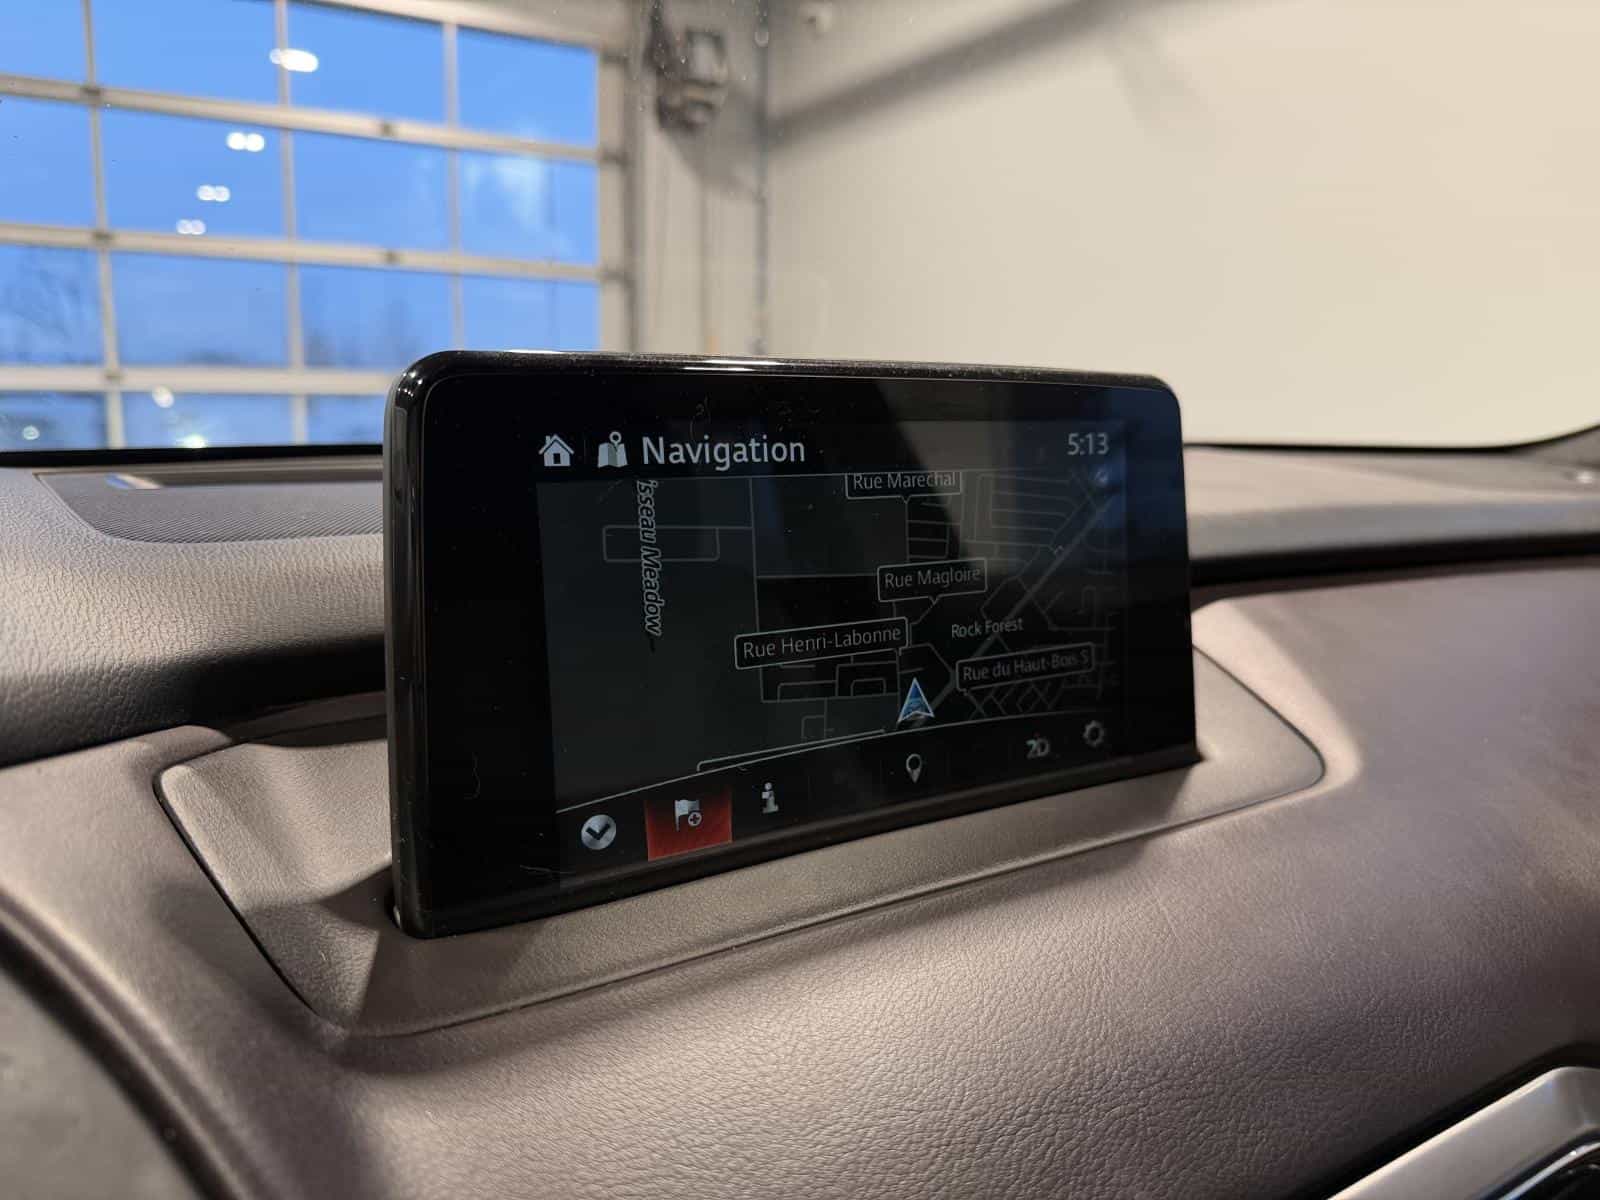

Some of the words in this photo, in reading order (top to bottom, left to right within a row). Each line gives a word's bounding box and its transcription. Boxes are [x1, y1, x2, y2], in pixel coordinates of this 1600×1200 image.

[641, 434, 805, 471] Navigation
[1066, 432, 1110, 456] 5:13
[853, 472, 883, 490] Rue
[884, 571, 913, 588] Rue
[917, 566, 981, 586] Magloire
[640, 545, 665, 637] Meadow
[951, 621, 982, 639] Rock
[985, 618, 1024, 634] Forest
[743, 641, 776, 660] Rue
[781, 627, 902, 653] Henri-Labonne
[963, 665, 989, 681] Rue
[992, 664, 1011, 678] du
